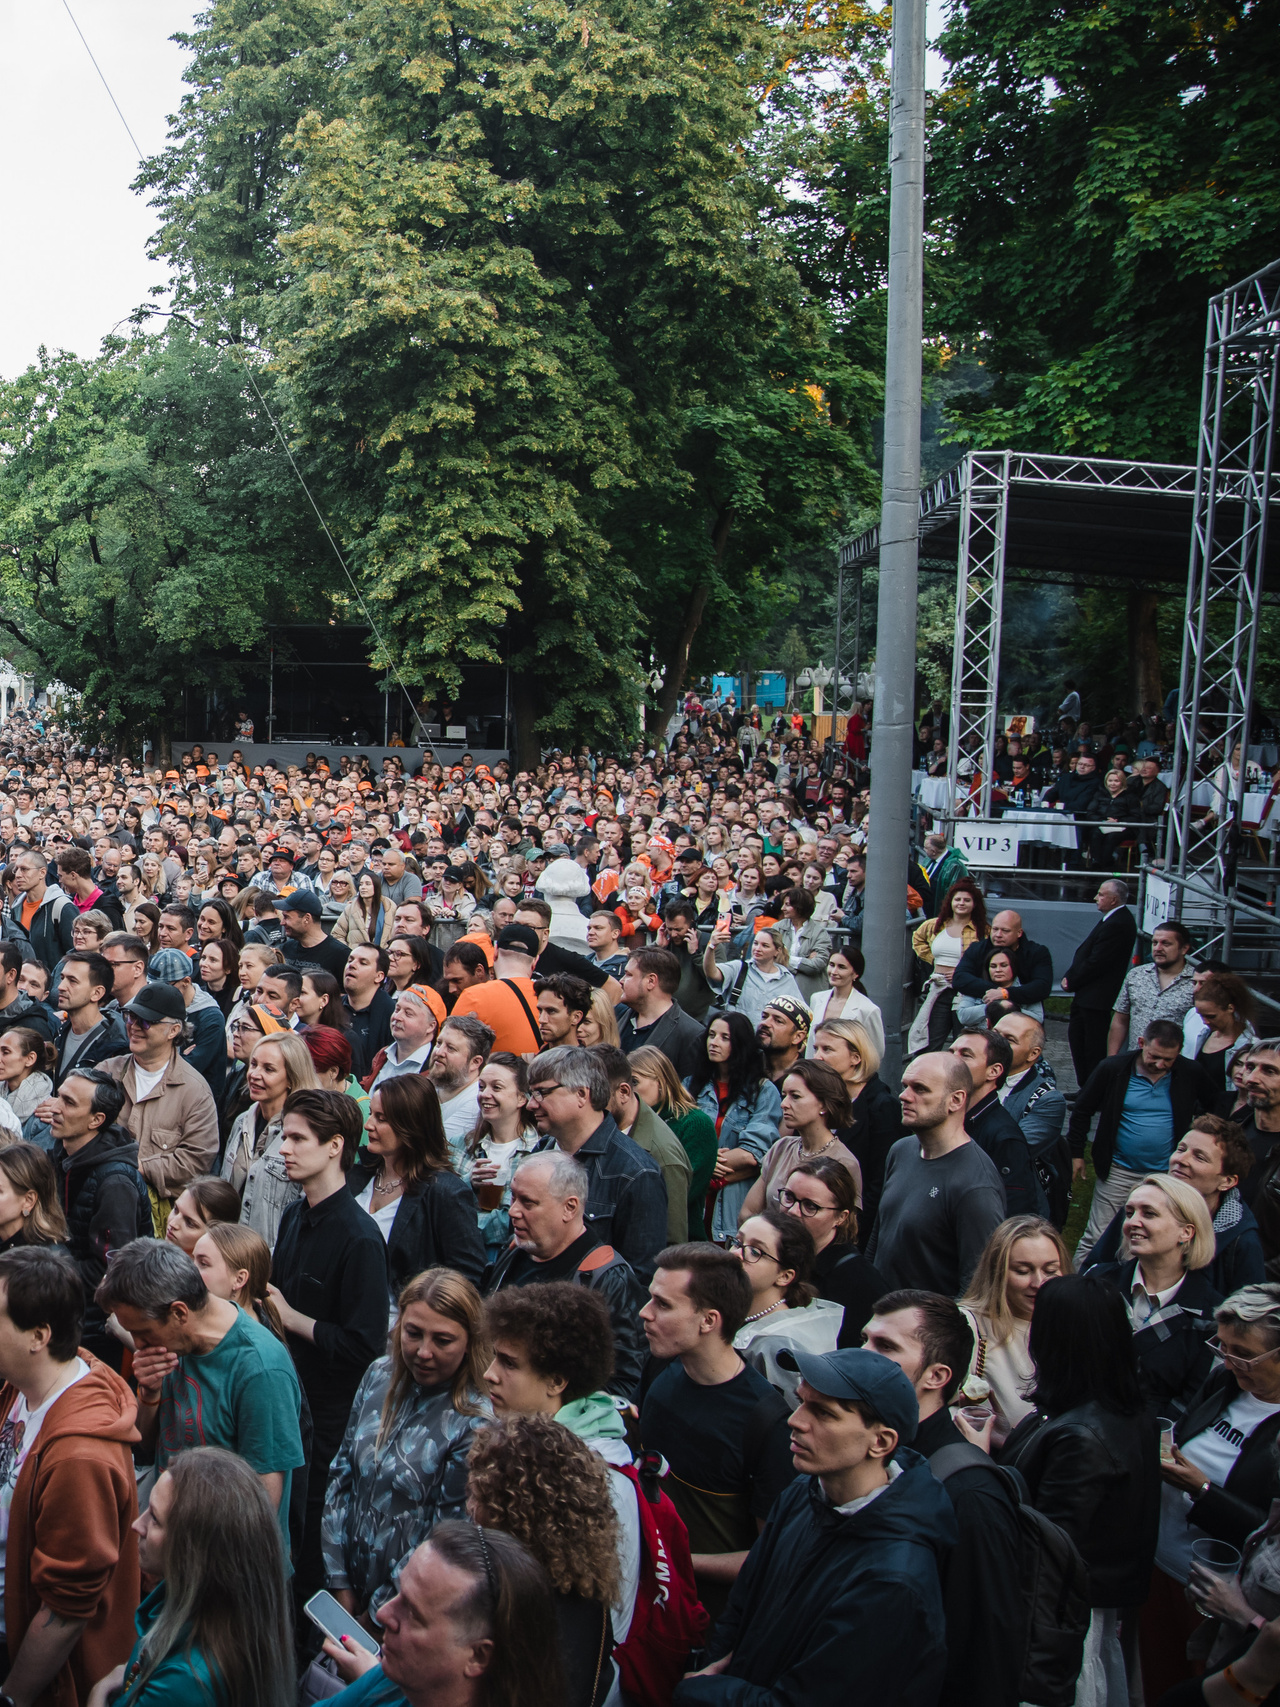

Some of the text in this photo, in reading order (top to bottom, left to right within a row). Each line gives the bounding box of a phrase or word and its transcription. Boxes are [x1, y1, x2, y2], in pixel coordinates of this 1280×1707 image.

[962, 836, 1011, 853] VIP 3
[1146, 893, 1166, 919] VIP 2
